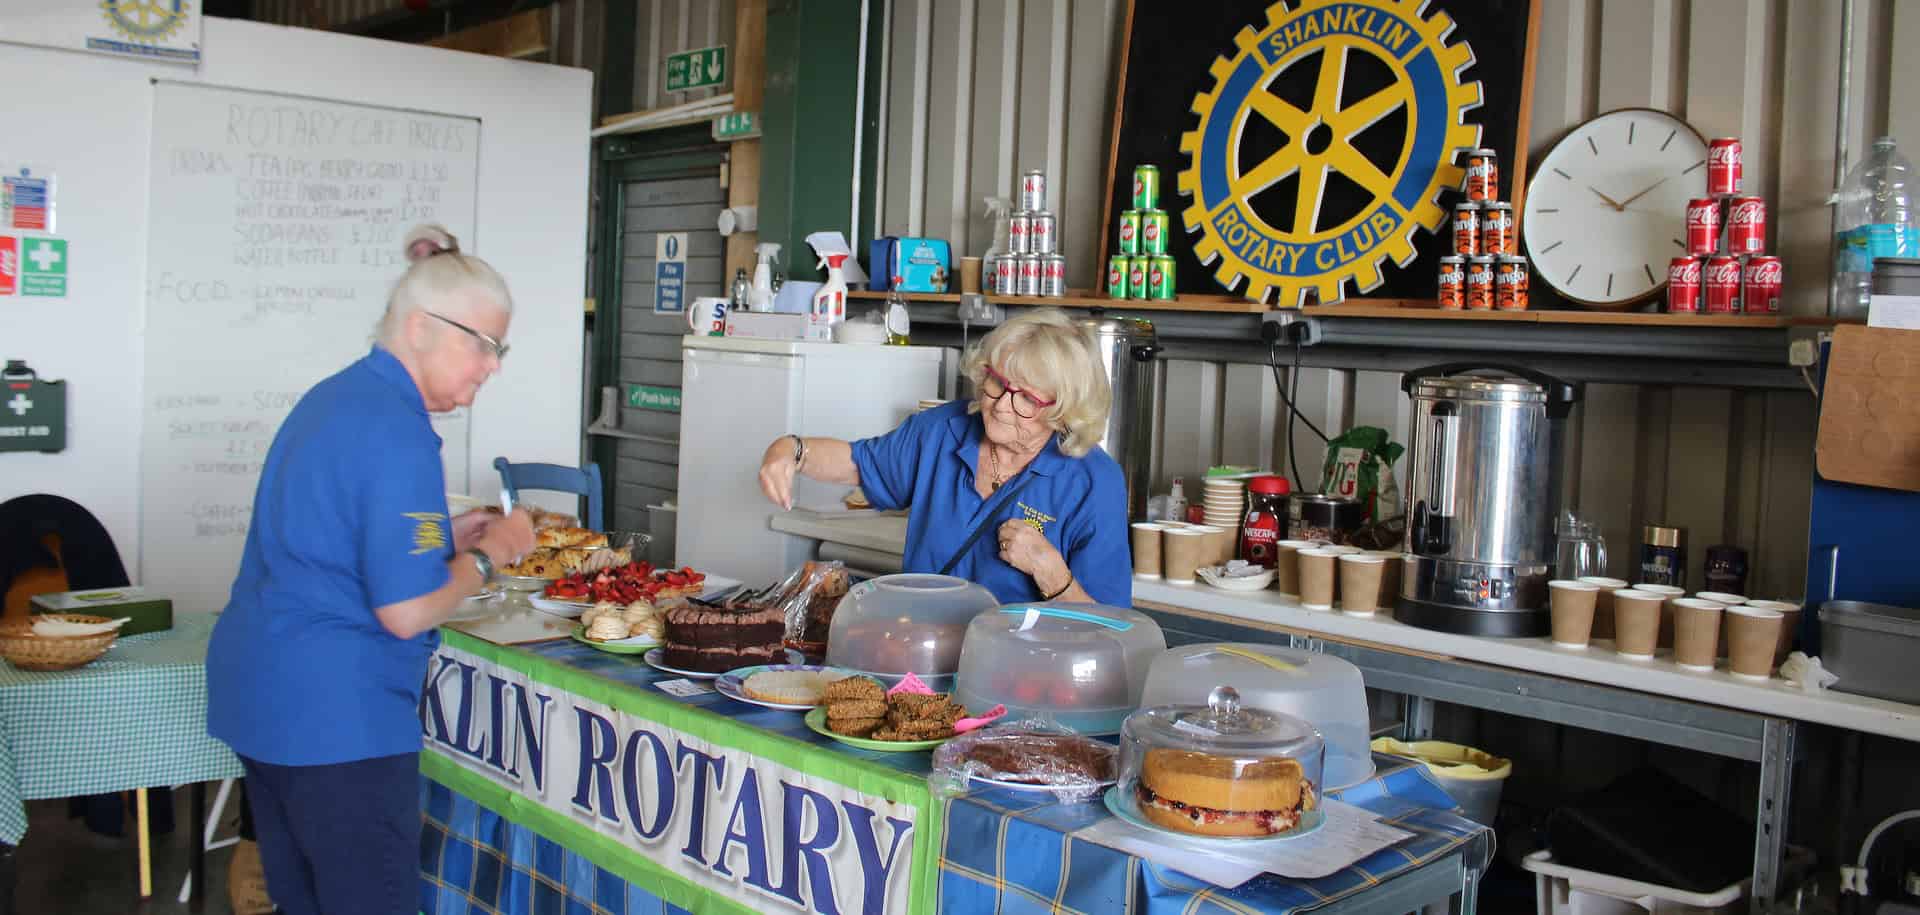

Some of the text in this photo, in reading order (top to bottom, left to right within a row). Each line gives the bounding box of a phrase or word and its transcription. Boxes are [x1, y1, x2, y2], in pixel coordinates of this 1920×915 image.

[1269, 6, 1411, 56] SHANKLIN
[226, 104, 343, 148] ROTARY
[1217, 207, 1396, 274] ROTARY CLUB
[422, 656, 913, 915] KLIN ROTARY
